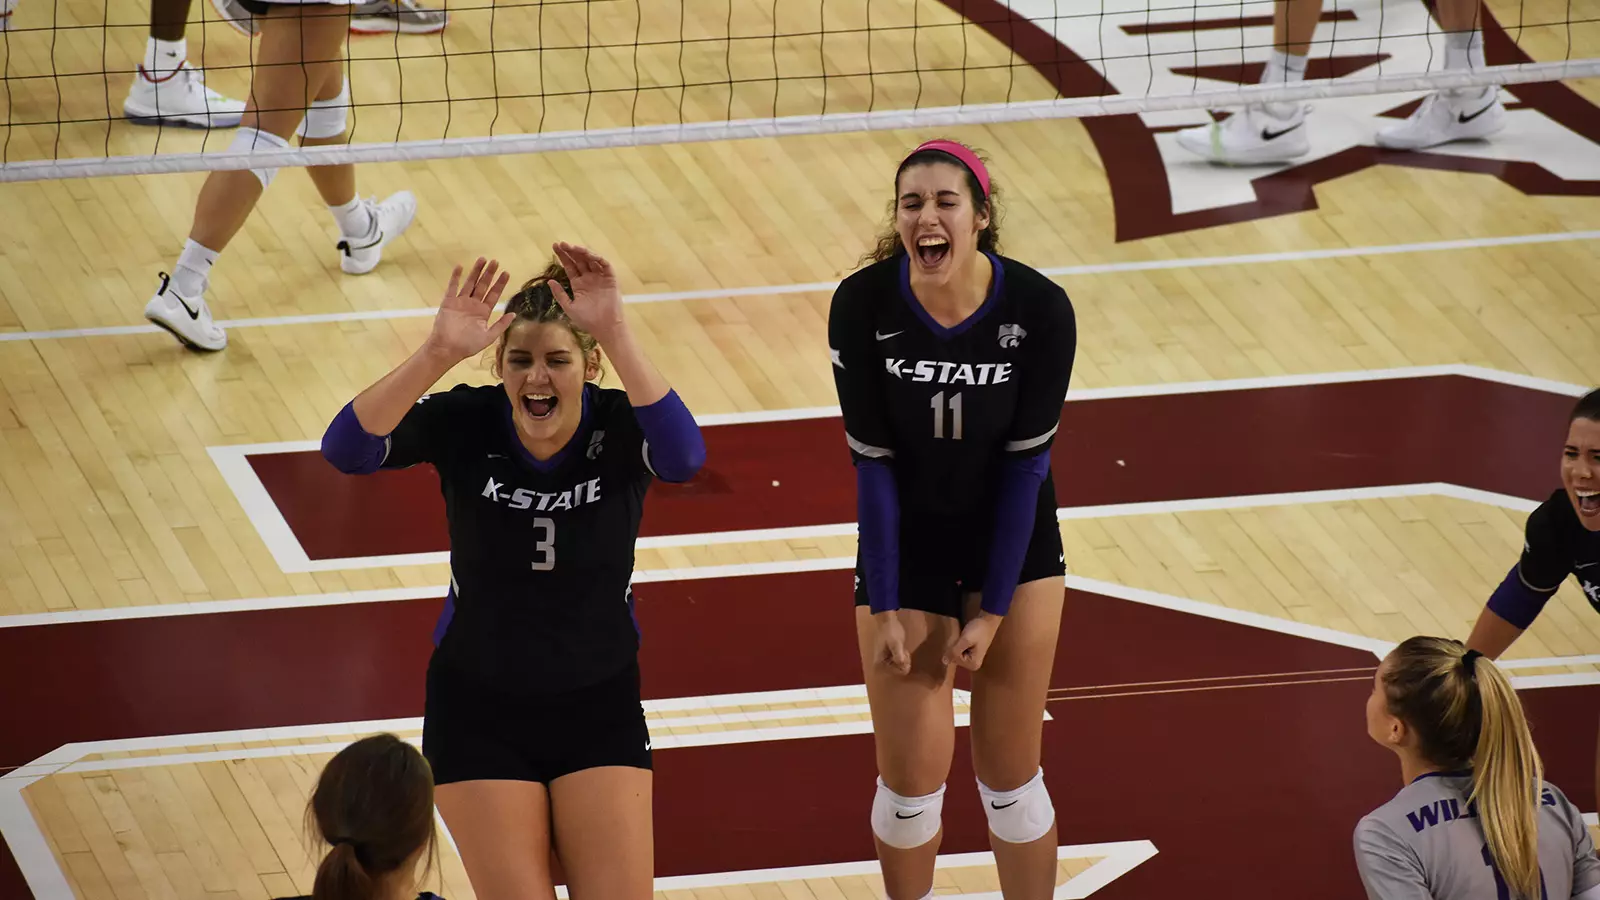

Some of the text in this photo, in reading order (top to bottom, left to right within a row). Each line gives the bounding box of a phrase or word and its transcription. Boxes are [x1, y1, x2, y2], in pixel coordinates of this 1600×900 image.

[885, 358, 1012, 385] K-STATE
[930, 390, 963, 440] 11
[481, 476, 601, 511] K-STATE
[531, 517, 556, 571] 3
